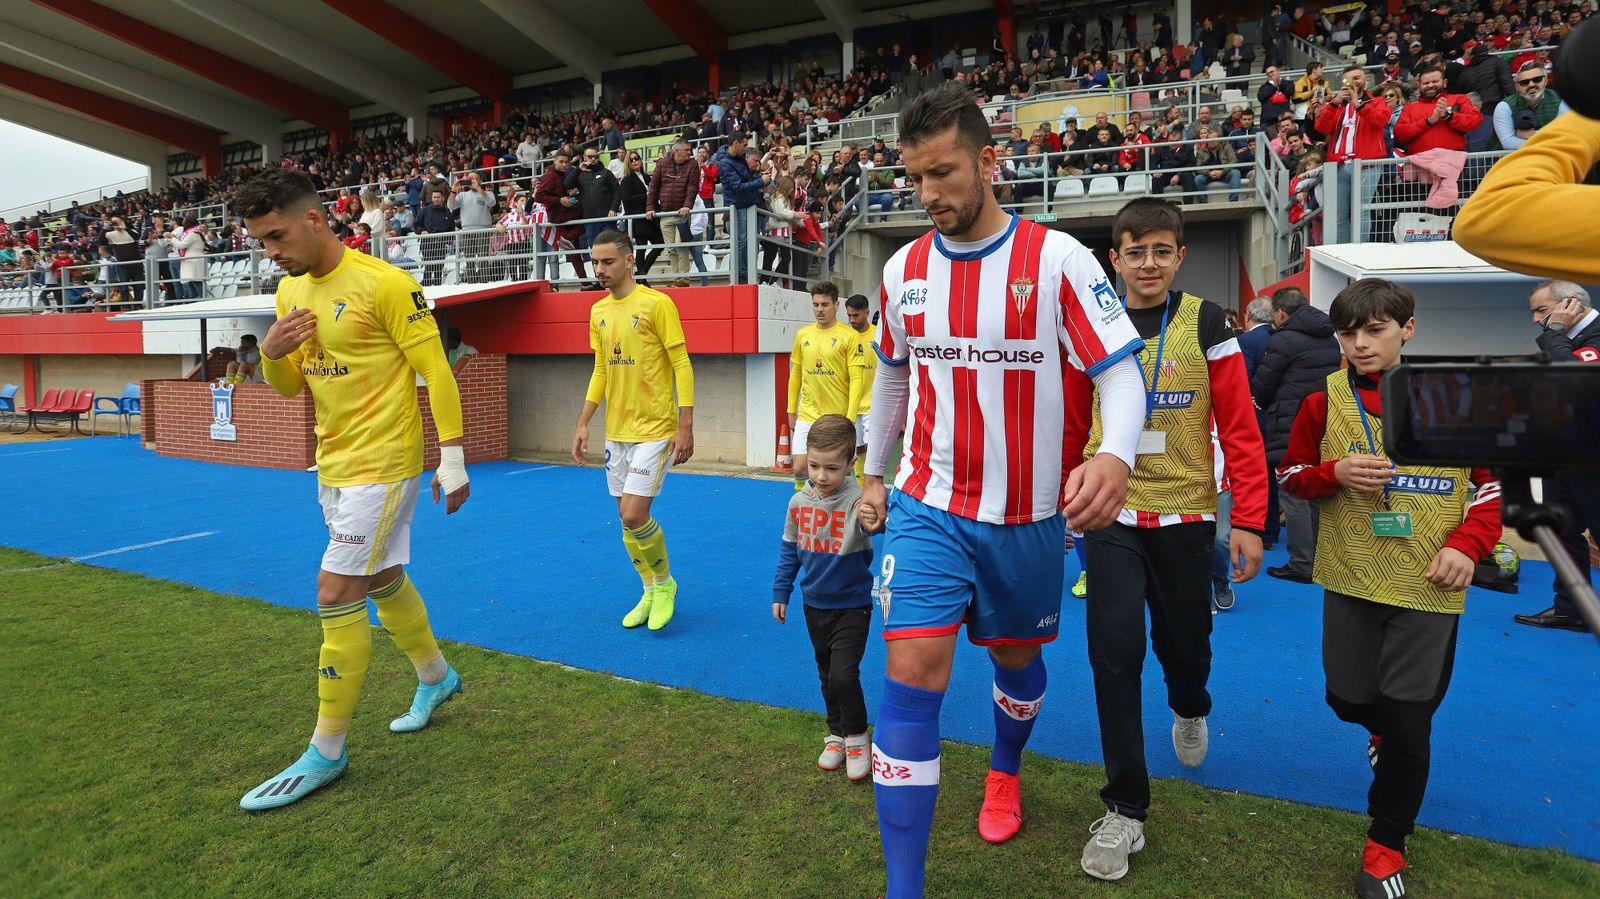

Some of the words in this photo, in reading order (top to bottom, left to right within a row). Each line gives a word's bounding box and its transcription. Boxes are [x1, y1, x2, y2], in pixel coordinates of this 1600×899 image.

[968, 345, 1044, 364] house
[790, 506, 846, 538] PEPE
[345, 534, 366, 542] CADIZ
[882, 554, 895, 586] 9
